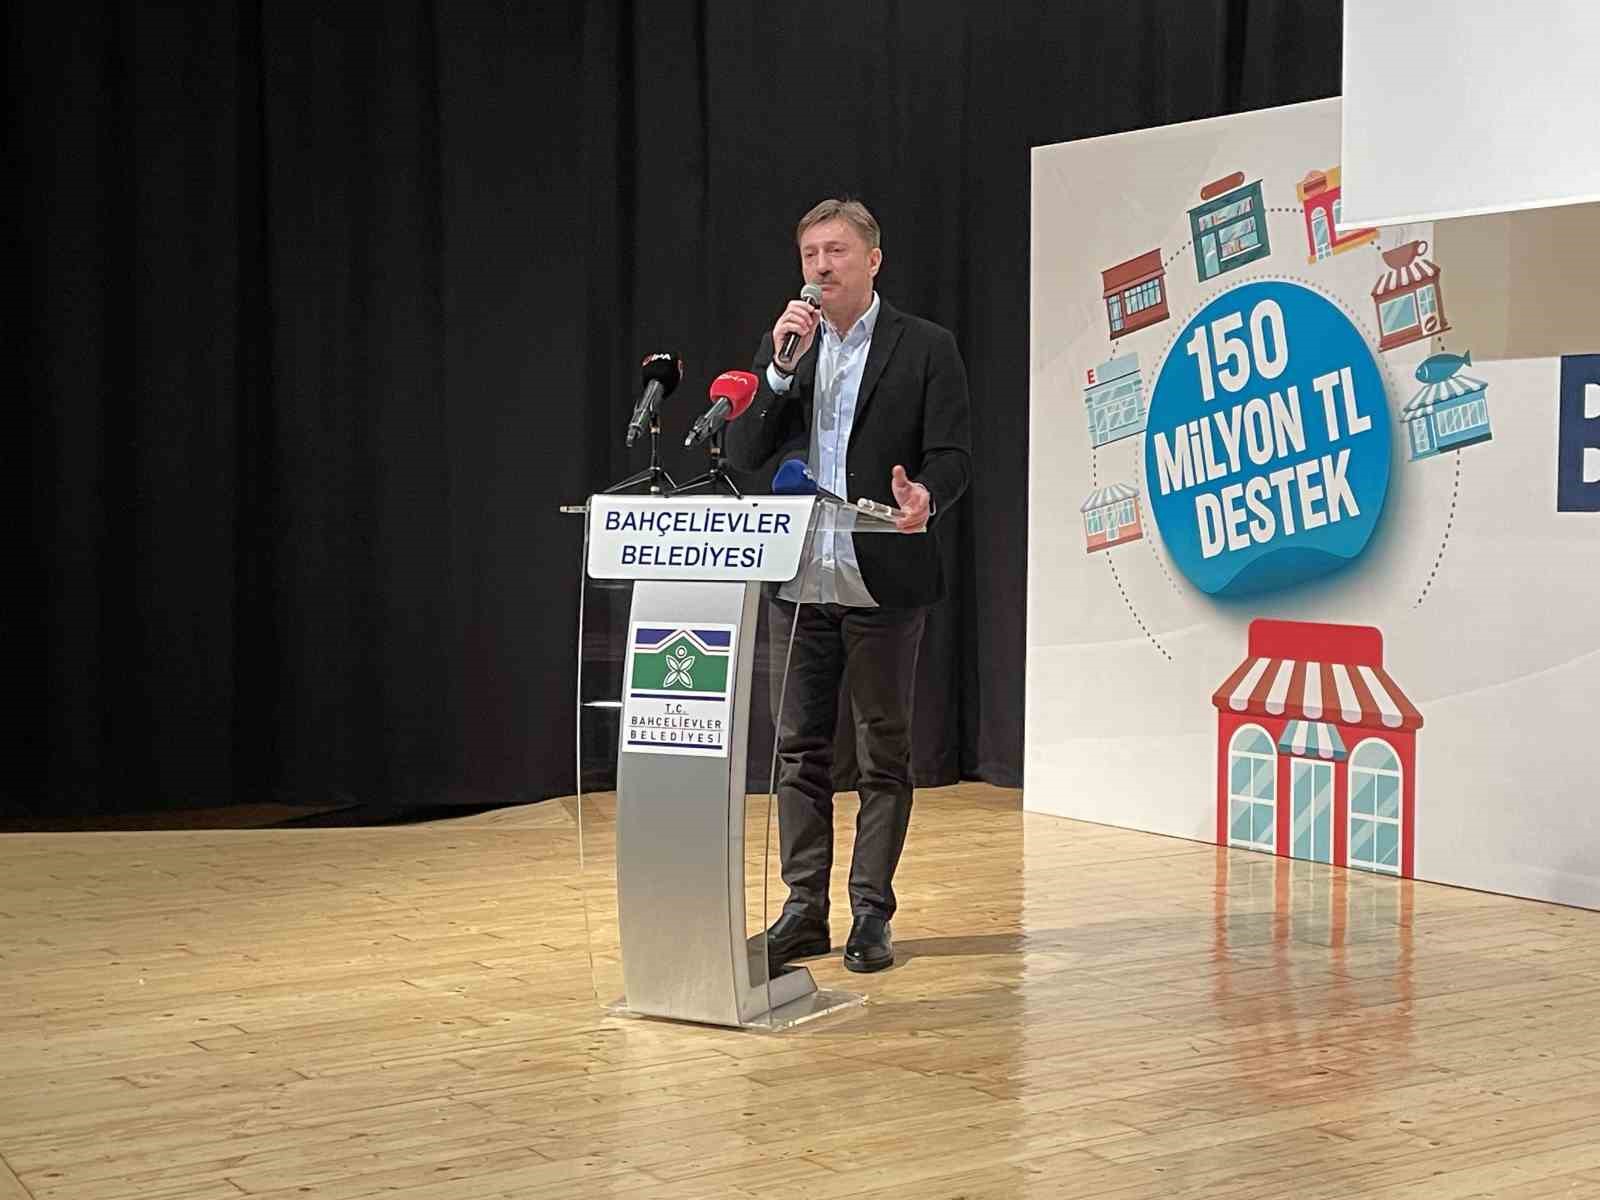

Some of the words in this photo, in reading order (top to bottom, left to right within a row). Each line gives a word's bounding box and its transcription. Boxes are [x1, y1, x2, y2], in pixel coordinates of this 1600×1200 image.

[1087, 368, 1096, 385] E
[1186, 299, 1289, 402] 150
[1312, 366, 1372, 442] TL
[605, 508, 791, 537] BAHÇELİEVLER
[1195, 448, 1360, 559] DESTEK
[621, 542, 764, 568] BELEDİYESİ
